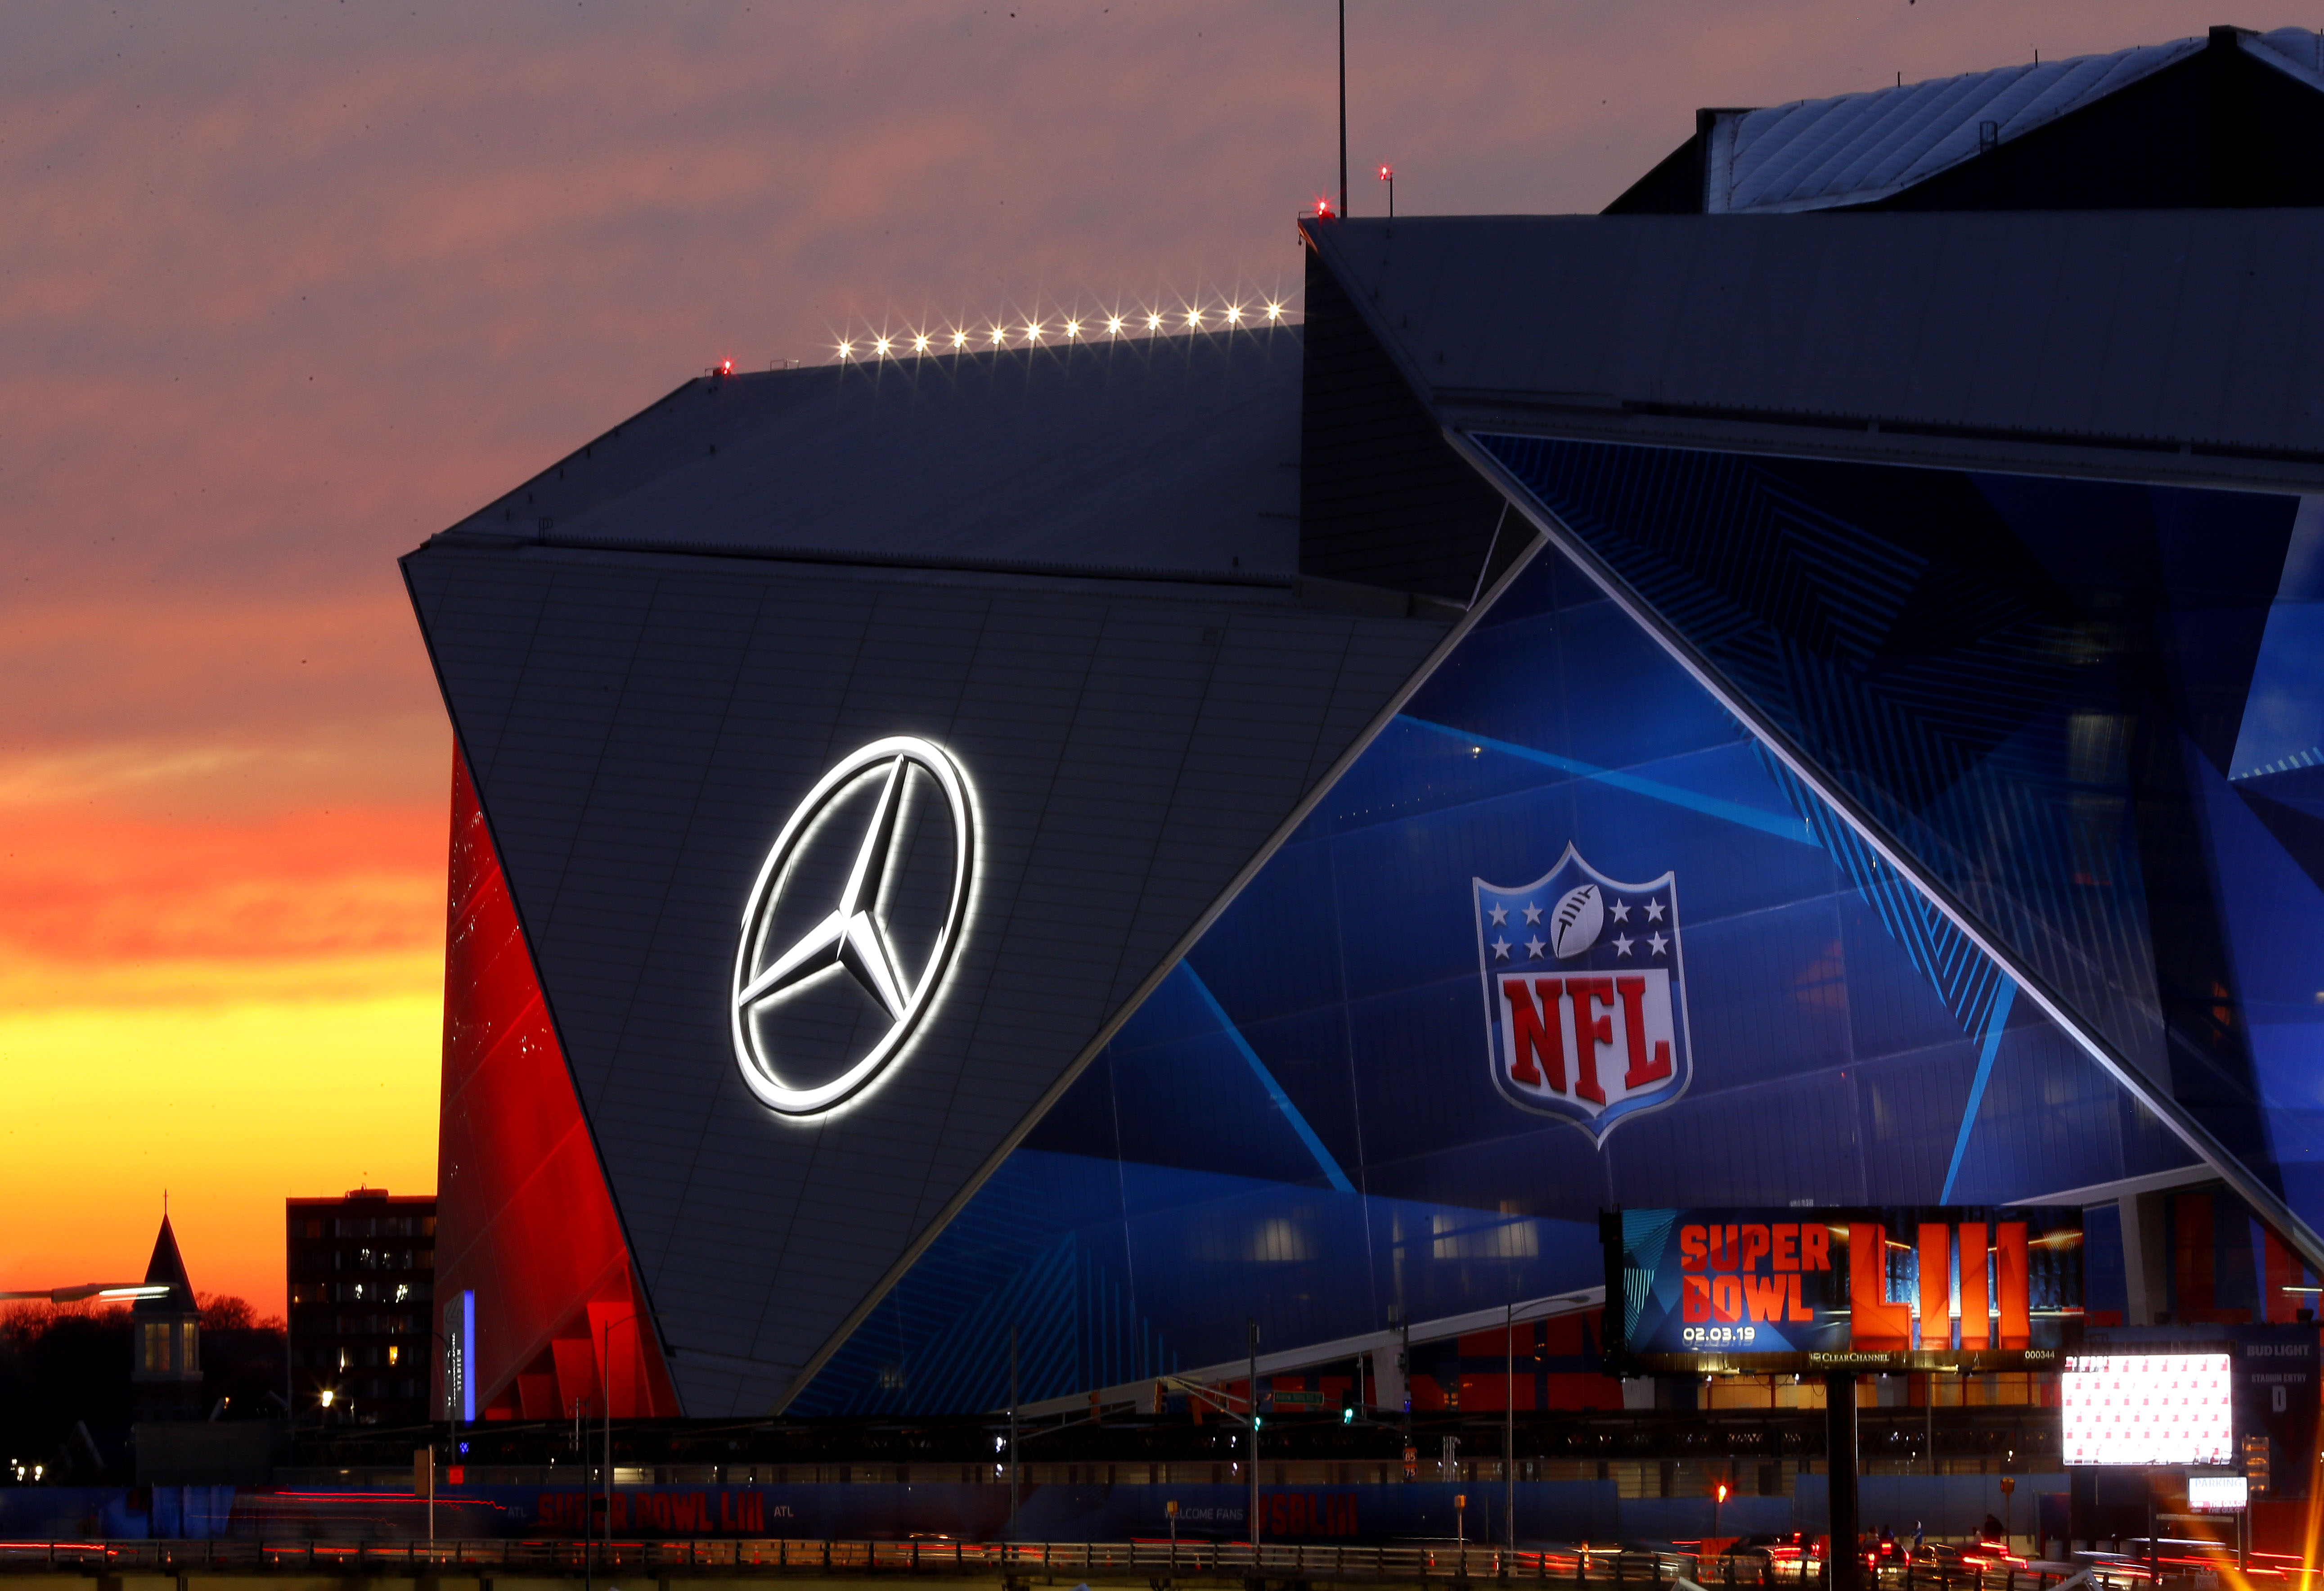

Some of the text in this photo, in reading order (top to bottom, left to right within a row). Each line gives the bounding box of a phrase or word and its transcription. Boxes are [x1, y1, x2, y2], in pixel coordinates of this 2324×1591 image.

[1504, 975, 1672, 1106] NFL
[1681, 1223, 1831, 1271] SUPER
[1849, 1222, 2030, 1349] LIII
[1683, 1274, 1814, 1322] BOWL
[1683, 1326, 1755, 1341] 02.03.19
[2025, 1350, 2055, 1359] 000344
[2247, 1344, 2310, 1357] BUD LIGHT
[2251, 1373, 2306, 1383] STADIUM ENTRY
[2272, 1385, 2287, 1413] D
[1405, 1468, 1416, 1477] 75
[2195, 1478, 2242, 1487] PARKING
[508, 1506, 527, 1518] ATL
[635, 1492, 714, 1532] BOWL
[721, 1492, 764, 1532] LIII
[774, 1505, 794, 1518] ATL
[1216, 1508, 1244, 1520] FANS
